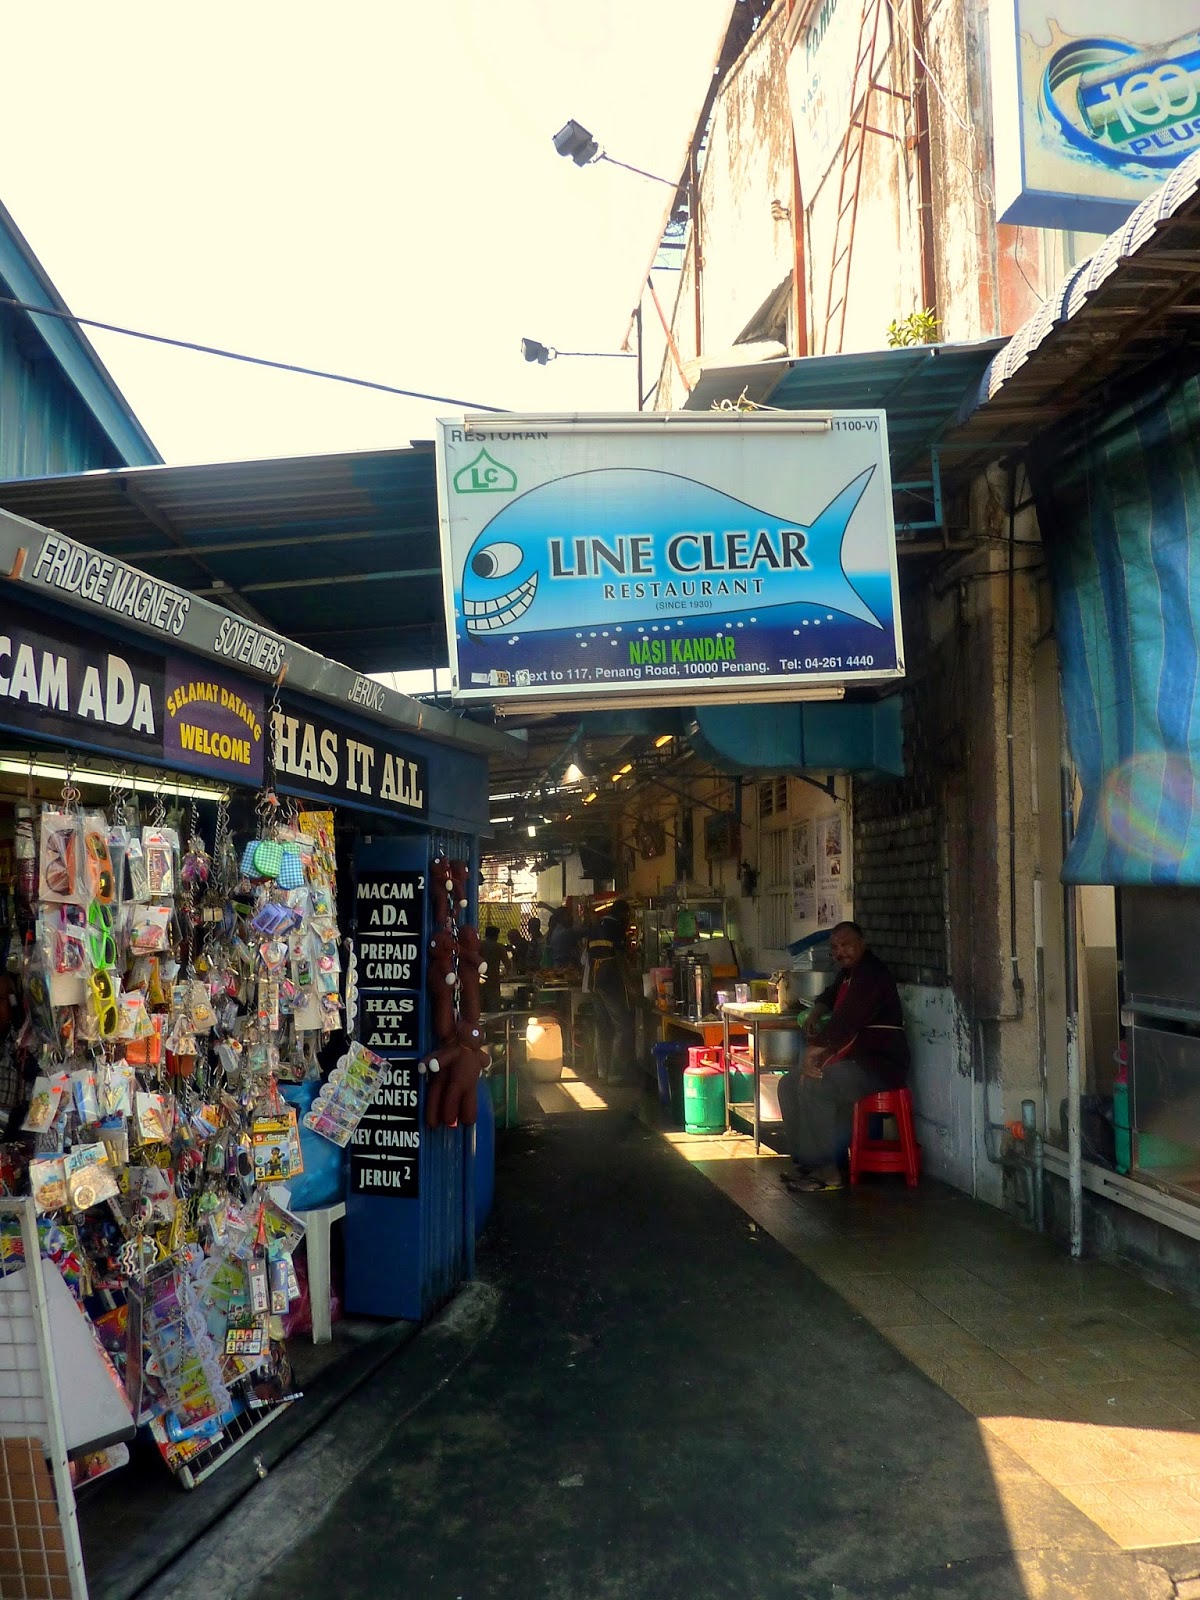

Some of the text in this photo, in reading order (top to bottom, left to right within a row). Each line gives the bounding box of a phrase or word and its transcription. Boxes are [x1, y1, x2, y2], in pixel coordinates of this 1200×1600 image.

[1101, 64, 1197, 134] 100
[471, 468, 499, 488] LC
[550, 531, 811, 577] LINE CLEAR
[32, 534, 191, 635] FRIDGE MAGNETS
[604, 579, 764, 599] RESTAURANT
[655, 600, 713, 610] (SINCE 1930)
[214, 617, 286, 675] SOVENIERS
[629, 636, 737, 664] NASI KANDAR
[550, 670, 564, 681] to
[566, 669, 592, 682] 117,
[595, 667, 643, 680] Penang
[645, 665, 680, 677] Road,
[683, 662, 719, 674] 10000
[721, 661, 770, 674] Penang.
[779, 659, 802, 670] Tel:
[804, 656, 842, 668] 04-261
[846, 655, 874, 667] 4440
[77, 653, 156, 735] ADA
[167, 682, 262, 742] SELAMAT DATANG
[180, 722, 251, 765] WELCOME
[271, 711, 423, 809] HAS IT ALL
[356, 883, 415, 900] MACAM
[369, 904, 409, 926] ADA
[360, 943, 418, 961] PREPAID
[365, 962, 411, 980] CARDS
[365, 999, 414, 1013] HAS
[376, 1015, 402, 1029] IT
[366, 1032, 413, 1047] ALL
[351, 1128, 420, 1149] KEY CHAINS
[359, 1168, 402, 1189] JERUK
